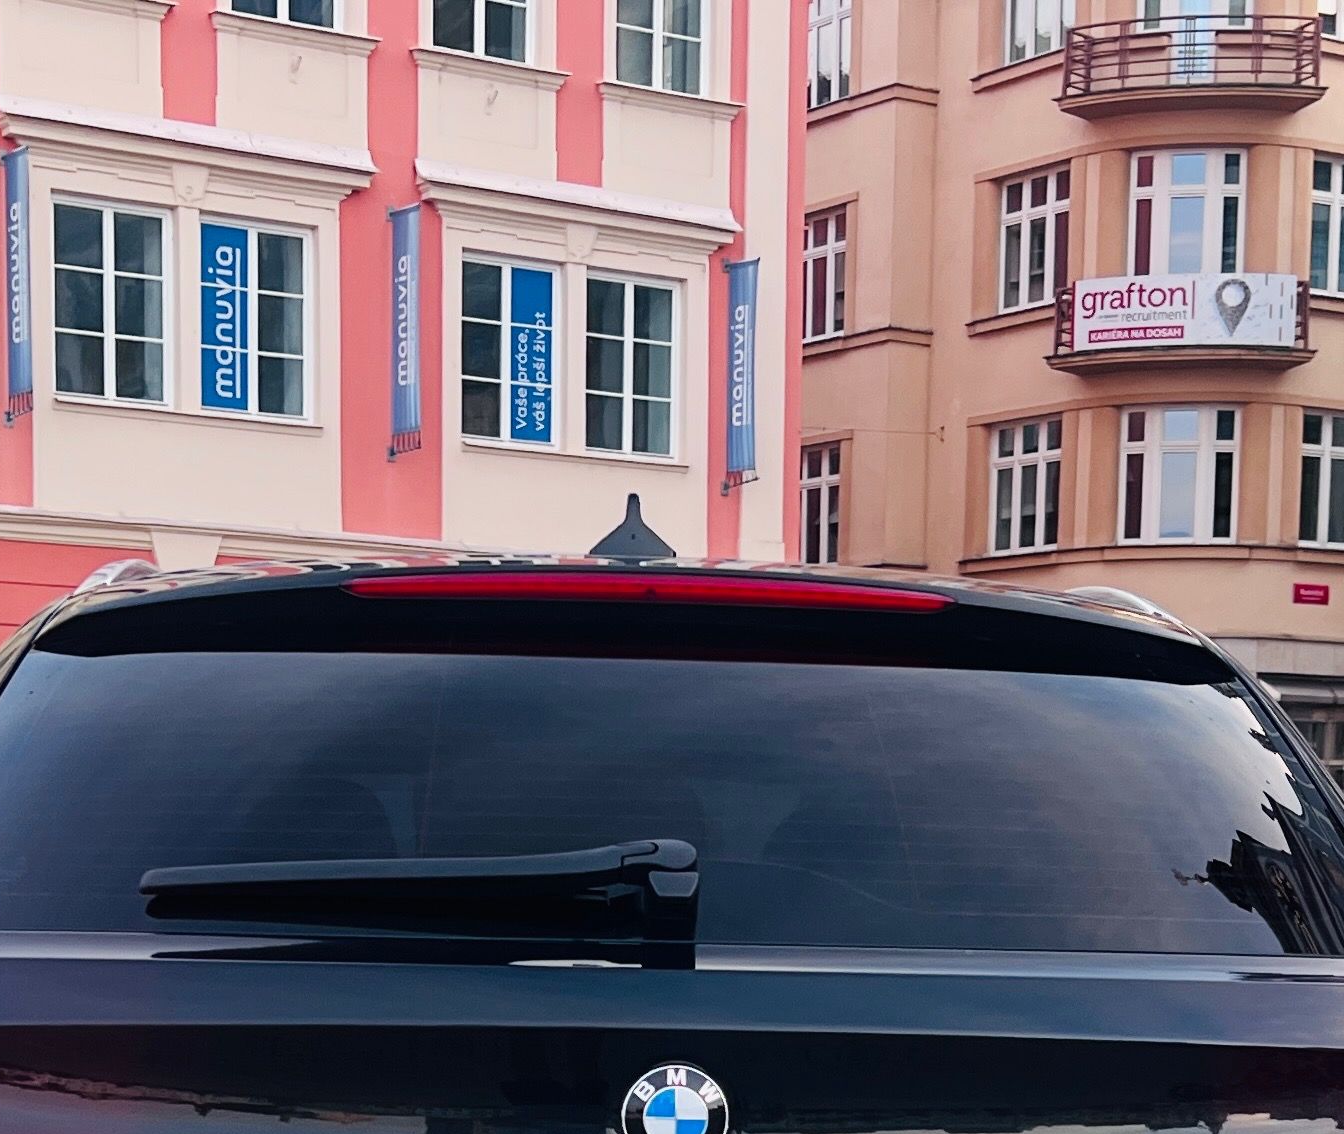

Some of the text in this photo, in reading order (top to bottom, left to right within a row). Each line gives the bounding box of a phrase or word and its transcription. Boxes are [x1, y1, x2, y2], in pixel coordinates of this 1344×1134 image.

[8, 202, 20, 344] manuvia
[395, 255, 407, 386] manuvia
[1081, 282, 1188, 319] grafton
[1120, 309, 1188, 323] recruitment
[208, 245, 235, 399] manuvia
[1146, 326, 1182, 339] DOSAH
[731, 304, 745, 427] manuvia
[515, 387, 528, 430] Vaše
[532, 401, 546, 432] váš
[634, 1068, 720, 1104] BMW
